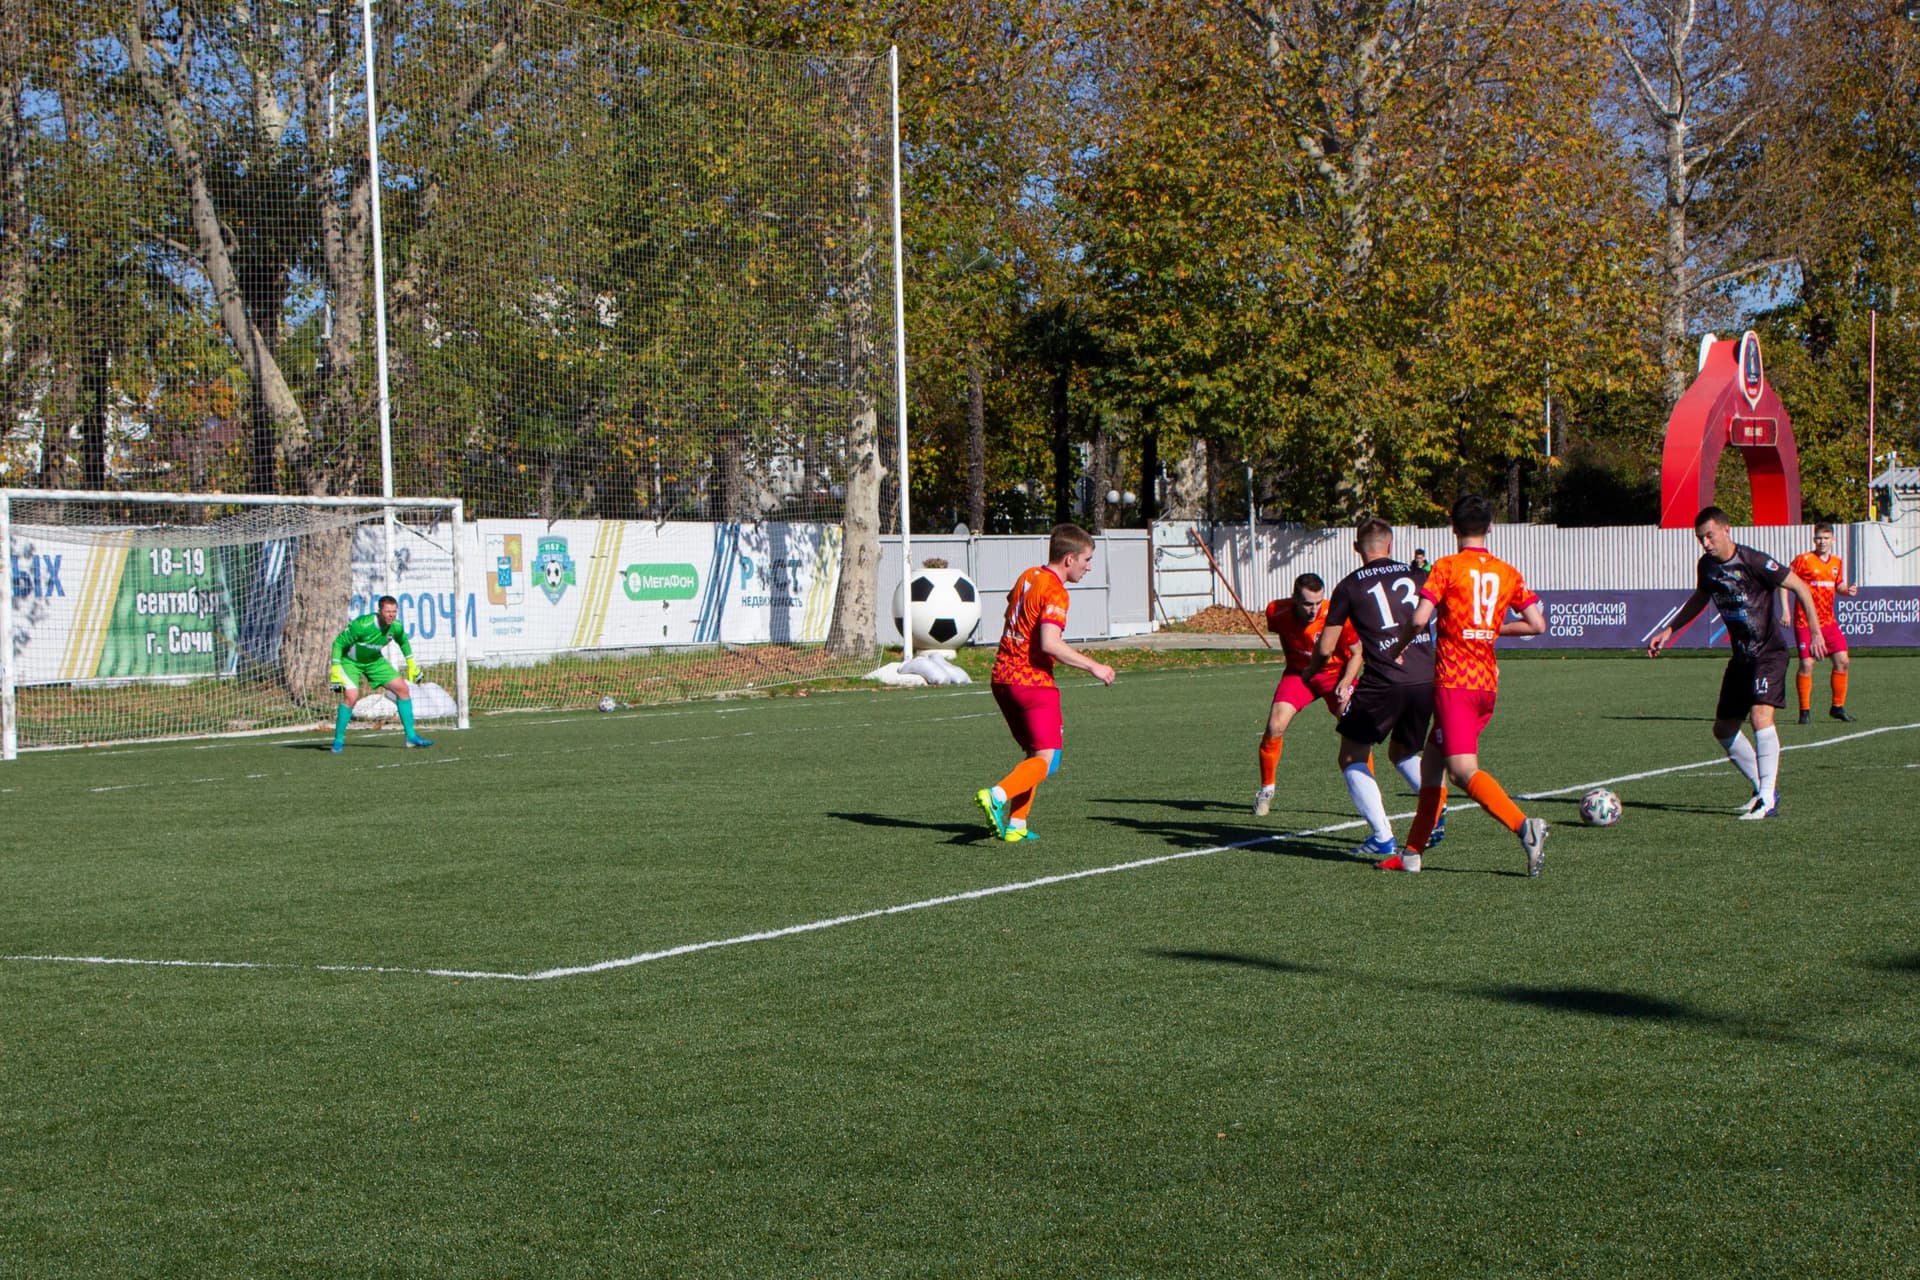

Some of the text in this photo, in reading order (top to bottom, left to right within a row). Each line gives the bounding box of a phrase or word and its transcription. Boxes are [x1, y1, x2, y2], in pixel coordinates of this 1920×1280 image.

[150, 548, 205, 576] 18-19
[136, 586, 219, 619] сентября
[1367, 577, 1420, 630] 13
[1469, 569, 1500, 627] 19
[1550, 602, 1627, 615] РОССИЙСКИЙ
[1838, 599, 1920, 612] РОССИЙСКИЙ
[398, 592, 478, 640] СОЧИ
[1550, 613, 1627, 626] ФУТБОЛЬНЫЙ
[1838, 610, 1920, 624] ФУТБОЛЬНЫЙ
[168, 625, 214, 654] Сочи
[1550, 625, 1584, 637] СОЮЗ
[1838, 623, 1874, 635] СОЮЗ
